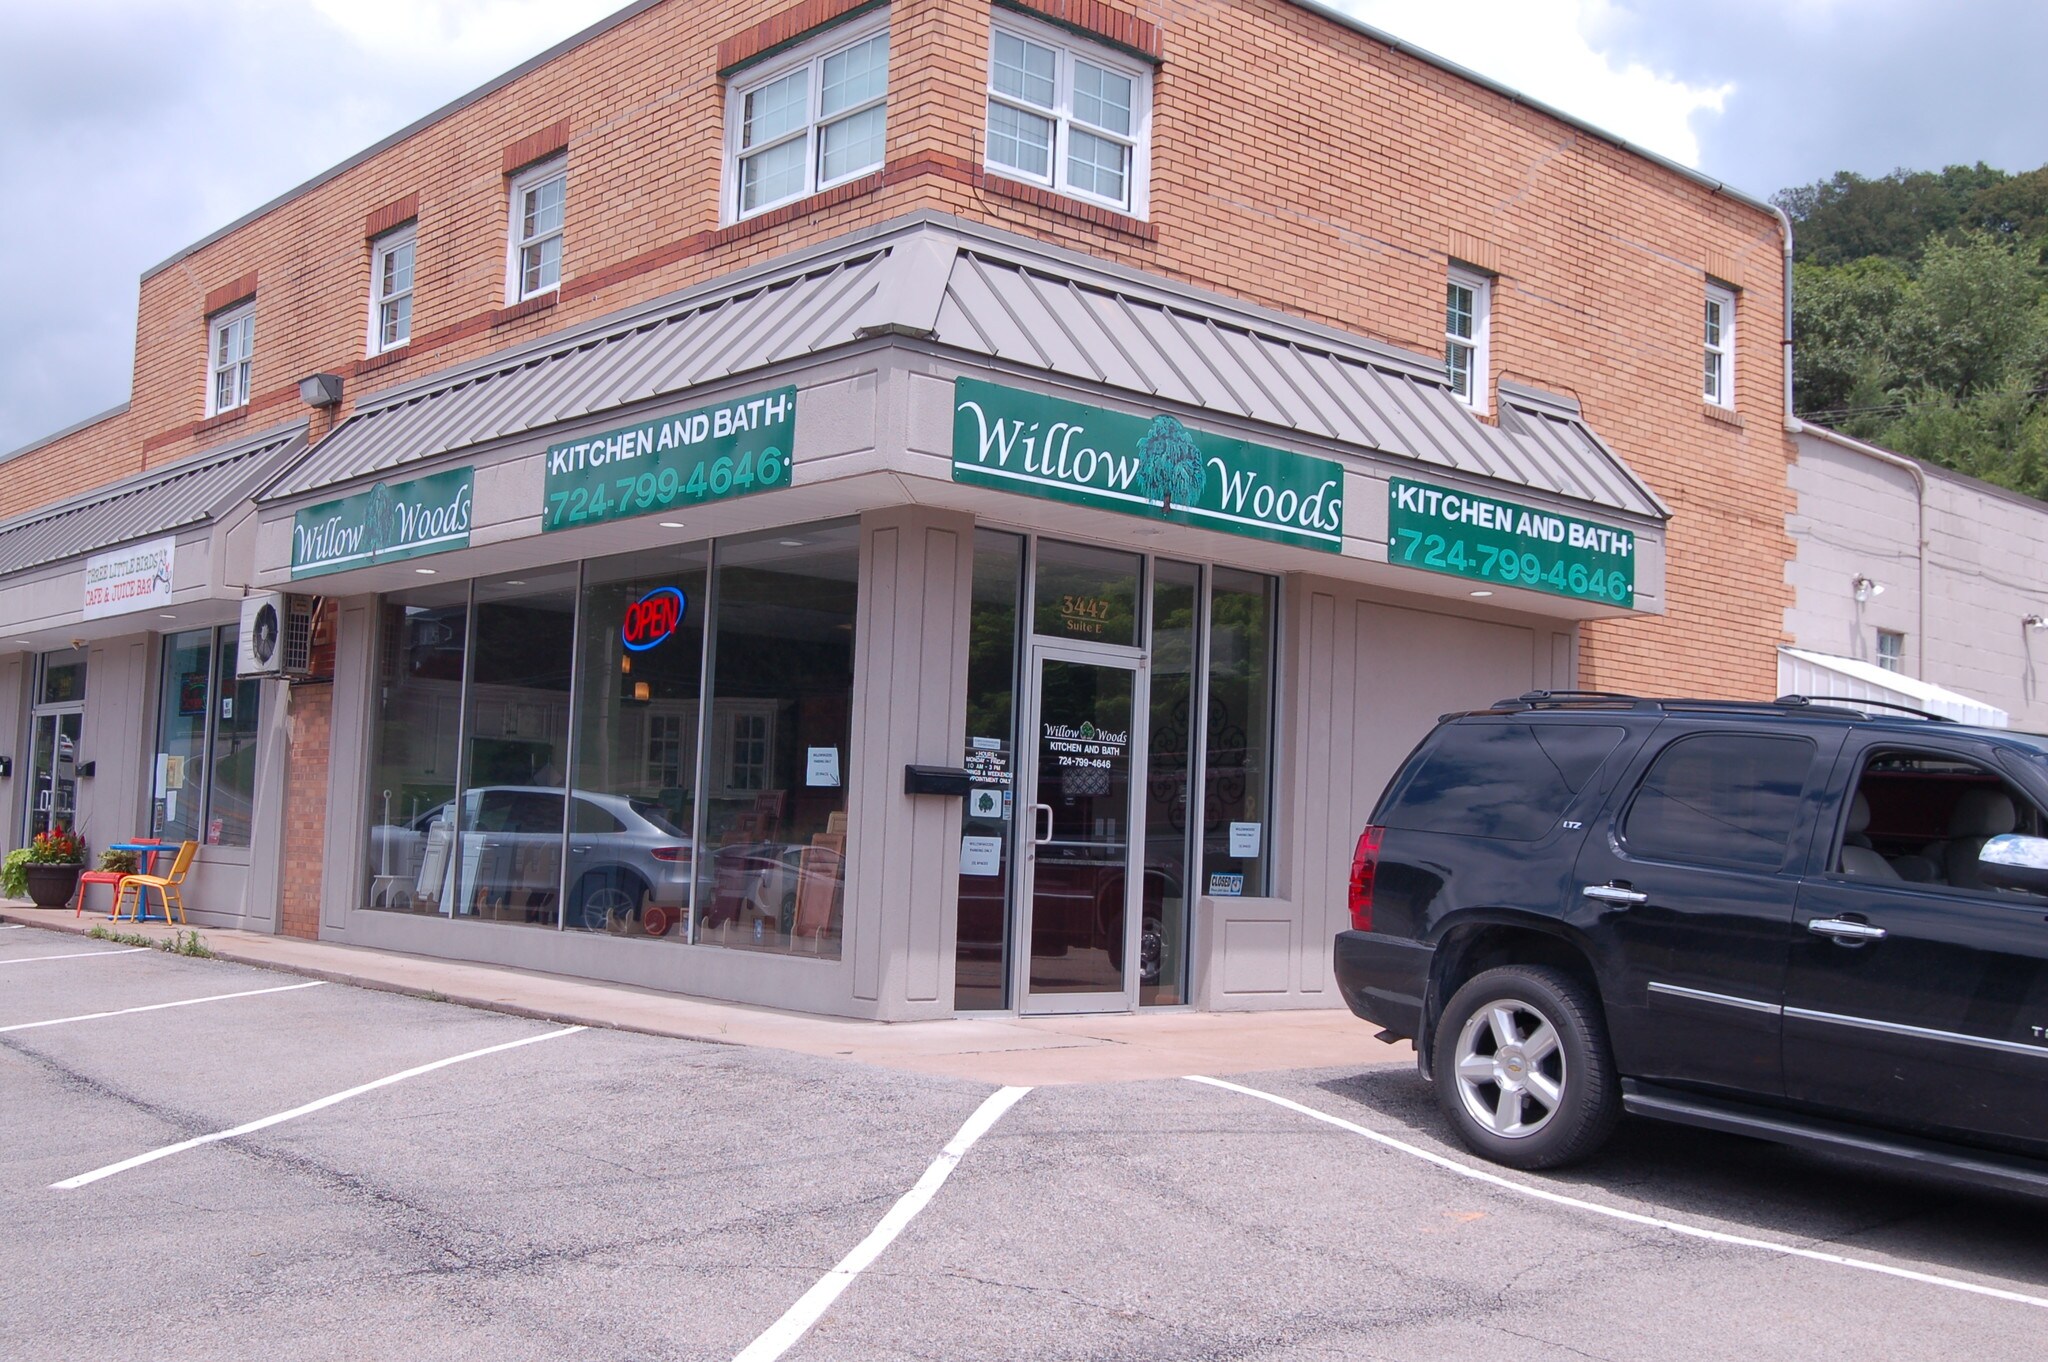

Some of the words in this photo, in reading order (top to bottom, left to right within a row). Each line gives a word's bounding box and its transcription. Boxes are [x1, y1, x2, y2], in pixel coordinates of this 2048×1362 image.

[551, 427, 654, 476] KITCHEN
[656, 414, 710, 452] AND
[713, 394, 787, 439] BATH
[957, 400, 1140, 491] Willow
[1207, 456, 1342, 532] Woods
[550, 446, 782, 525] 724-799-4646
[294, 515, 365, 564] Willow
[394, 483, 471, 543] Woods
[1397, 484, 1513, 533] KITCHEN
[1515, 512, 1565, 544] AND
[1568, 523, 1628, 558] BATH
[87, 564, 109, 585] THREE
[109, 557, 135, 579] LITTLE
[136, 552, 159, 573] BIRDS
[1397, 528, 1627, 601] 724-799-4646
[85, 588, 103, 606] CAFE
[111, 580, 136, 602] JUICE
[136, 578, 153, 596] BAR
[1062, 595, 1109, 619] 3447
[623, 595, 679, 642] OPEN
[1066, 620, 1092, 633] Suite
[1044, 723, 1080, 739] Willow
[1095, 728, 1128, 743] Woods
[1050, 741, 1082, 753] KITCHEN
[1084, 744, 1100, 755] AND
[1101, 746, 1120, 756] BATH
[1058, 756, 1112, 769] 724-799-4646
[1562, 820, 1583, 830] LTZ
[1211, 876, 1232, 888] CLOSED
